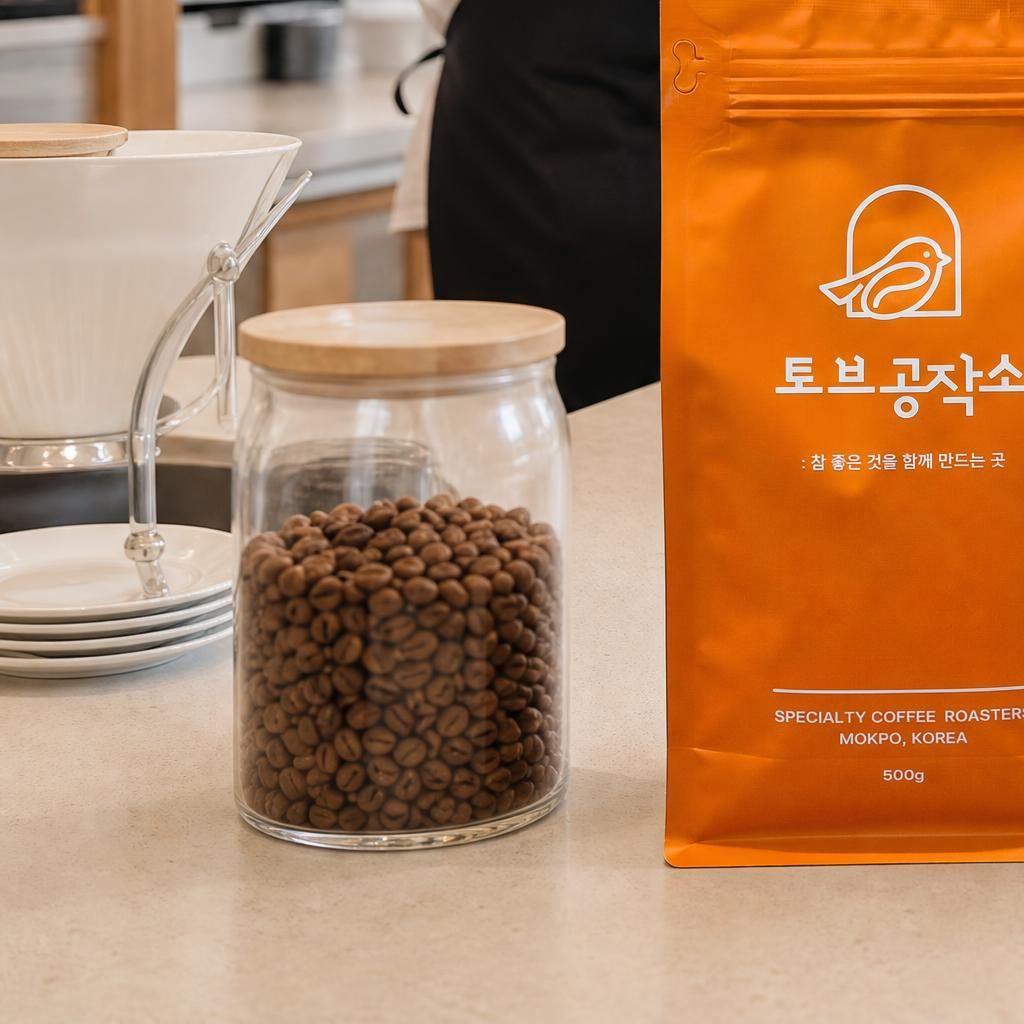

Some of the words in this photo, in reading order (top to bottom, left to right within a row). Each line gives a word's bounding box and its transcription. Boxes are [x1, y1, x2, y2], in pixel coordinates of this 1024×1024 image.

[811, 453, 827, 471] 참
[831, 454, 862, 471] 좋은
[867, 453, 898, 471] 것을
[902, 452, 933, 470] 함께
[938, 452, 986, 469] 만드는
[990, 451, 1006, 469] 곳
[774, 710, 866, 724] SPECIALTY
[871, 709, 936, 724] COFFEE
[839, 732, 906, 747] MOKPO,
[911, 731, 968, 745] KOREA
[883, 769, 925, 784] 500g
